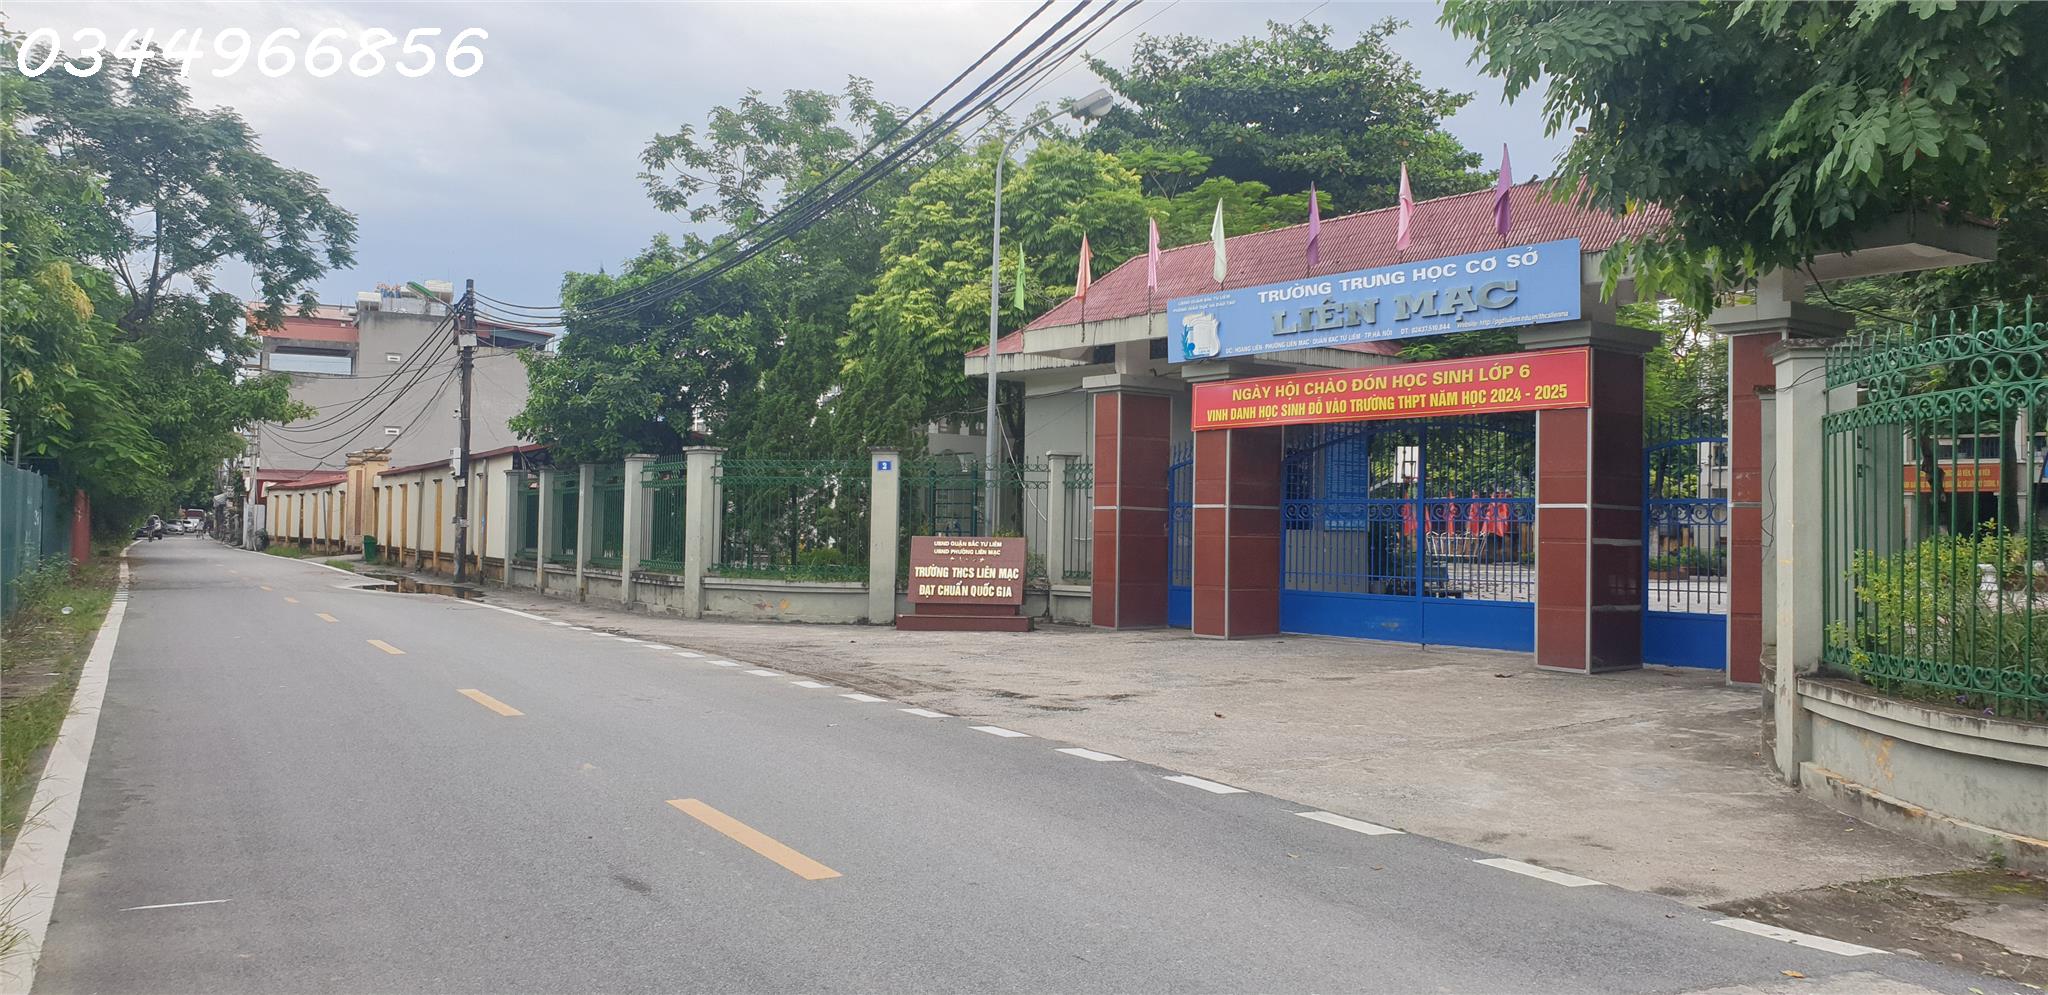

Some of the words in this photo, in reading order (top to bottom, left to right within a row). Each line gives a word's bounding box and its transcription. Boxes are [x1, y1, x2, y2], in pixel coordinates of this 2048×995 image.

[1257, 283, 1332, 304] TRƯỜNG
[1339, 271, 1405, 292] TRUNG
[1412, 263, 1457, 283] HỌC
[1465, 256, 1497, 274] CƠ
[1506, 246, 1539, 268] SỞ
[1272, 298, 1380, 336] LIÊN
[1393, 280, 1518, 322] MẠC
[1232, 384, 1271, 401] NGÀY
[1275, 381, 1300, 401] HỘI
[1304, 377, 1347, 396] CHÀO
[1351, 374, 1388, 392] ĐÓN
[1392, 373, 1428, 391] HỌC
[1432, 367, 1474, 386] SINH
[1479, 362, 1514, 382] LỚP
[1519, 364, 1531, 379] 6
[1207, 408, 1229, 422] VINH
[1230, 406, 1257, 421] DANH
[1258, 404, 1279, 421] HỌC
[1281, 401, 1306, 417] SINH
[1308, 396, 1323, 415] ĐỖ
[1326, 396, 1347, 414] VÀO
[1350, 393, 1395, 412] TRƯỜNG
[1397, 393, 1427, 410] THPT
[1429, 389, 1458, 408] NĂM
[1461, 389, 1487, 407] HỌC
[1490, 387, 1522, 404] 2024
[1534, 384, 1568, 400] 2025
[915, 563, 949, 578] TRƯỜNG
[952, 567, 975, 579] THCS
[976, 565, 996, 579] LIÊN
[998, 567, 1020, 581] MẠC
[919, 584, 936, 598] ĐẠT
[937, 580, 969, 596] CHUẨN
[970, 582, 995, 597] QUỐC
[996, 586, 1012, 597] GIA
